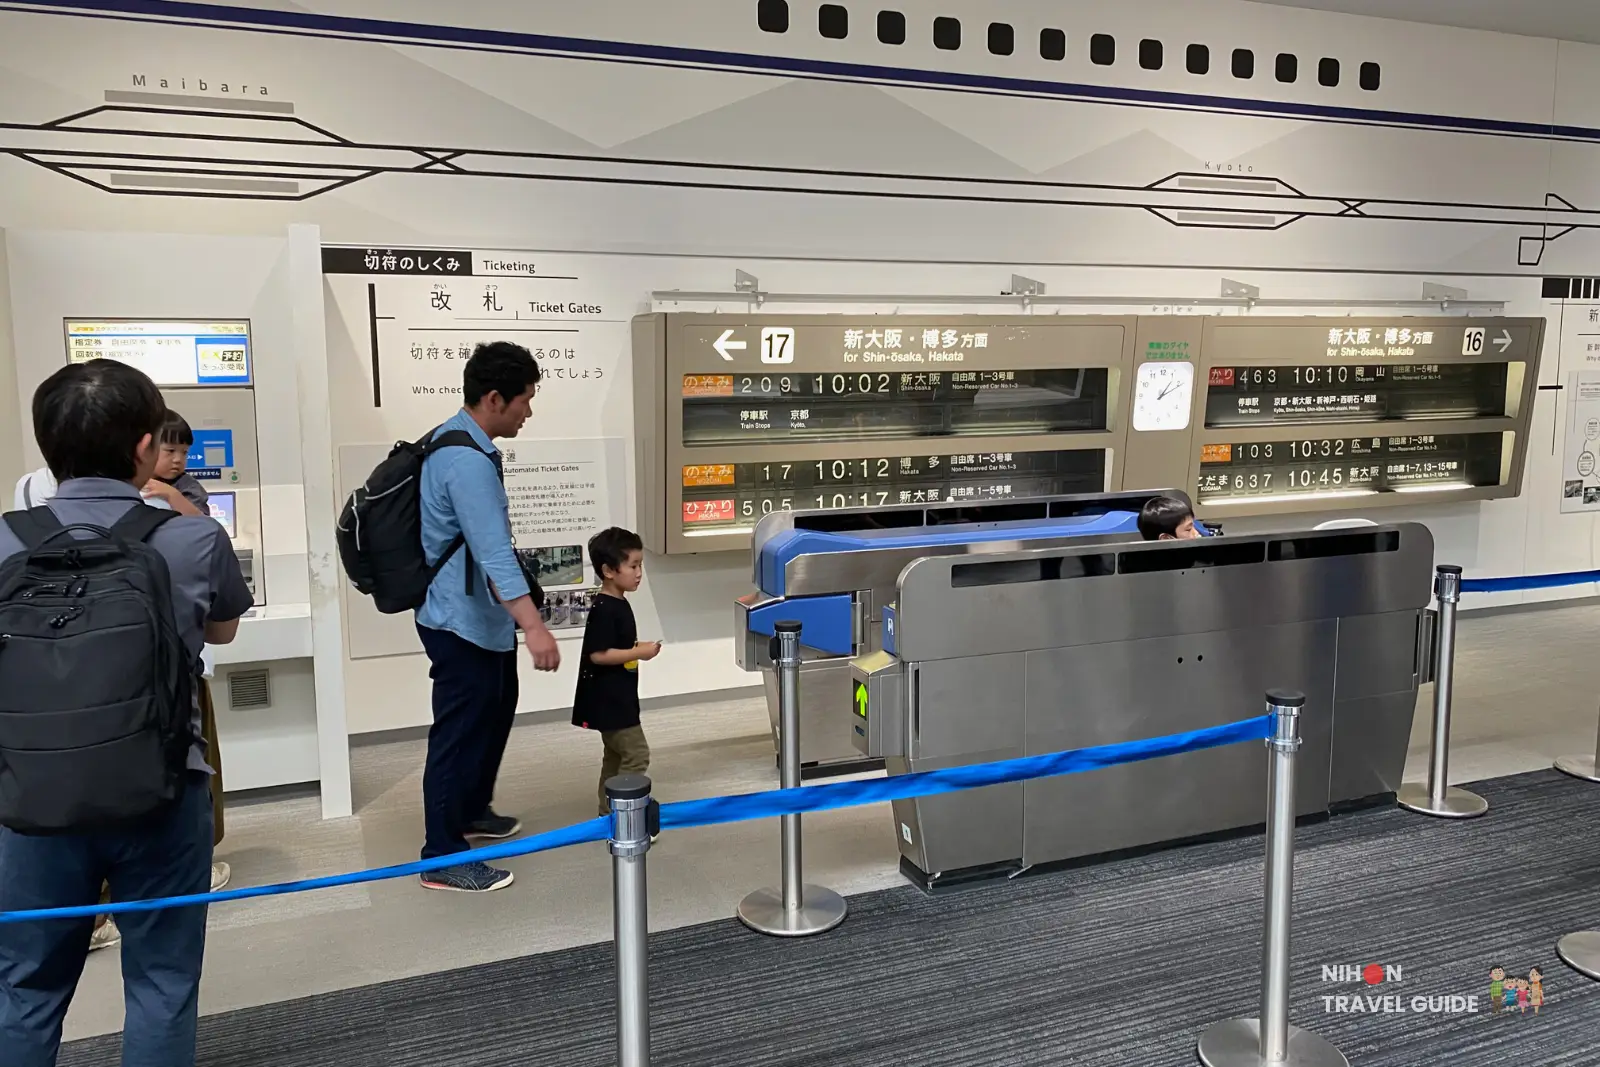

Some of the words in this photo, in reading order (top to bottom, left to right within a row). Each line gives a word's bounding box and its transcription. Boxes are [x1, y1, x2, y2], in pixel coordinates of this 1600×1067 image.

[132, 74, 268, 96] Maibara
[1204, 160, 1253, 173] Kyoto
[364, 255, 461, 271] 切符のしくみ
[483, 260, 536, 274] Ticketing
[529, 301, 564, 313] Ticket
[568, 302, 602, 314] Gates
[764, 334, 790, 358] 17
[1466, 332, 1483, 352] 16
[844, 352, 859, 362] for
[928, 352, 964, 362] Hakata
[1327, 347, 1337, 356] for
[1388, 347, 1415, 356] Hakata
[900, 373, 941, 385] 新大阪
[952, 373, 976, 382] 自由席
[1240, 369, 1276, 383] 463
[1293, 366, 1348, 384] 10:10
[412, 386, 435, 394] Who
[684, 376, 730, 390] のぞみ
[742, 377, 791, 392] 209
[815, 374, 890, 394] 10:02
[1238, 398, 1259, 406] 停車駅
[740, 410, 768, 421] 停車駅
[790, 409, 809, 420] 京都
[1238, 444, 1273, 458] 103
[1290, 439, 1344, 458] 10:32
[951, 454, 975, 464] 自由席
[686, 465, 732, 478] のぞみ
[763, 464, 792, 480] 17
[815, 458, 889, 480] 10:12
[1350, 466, 1379, 477] 新大阪
[1235, 473, 1272, 488] 637
[1288, 468, 1342, 487] 10:45
[899, 489, 939, 502] 新大阪
[950, 487, 974, 496] 自由席
[686, 500, 732, 514] ひかり
[742, 498, 792, 515] 505
